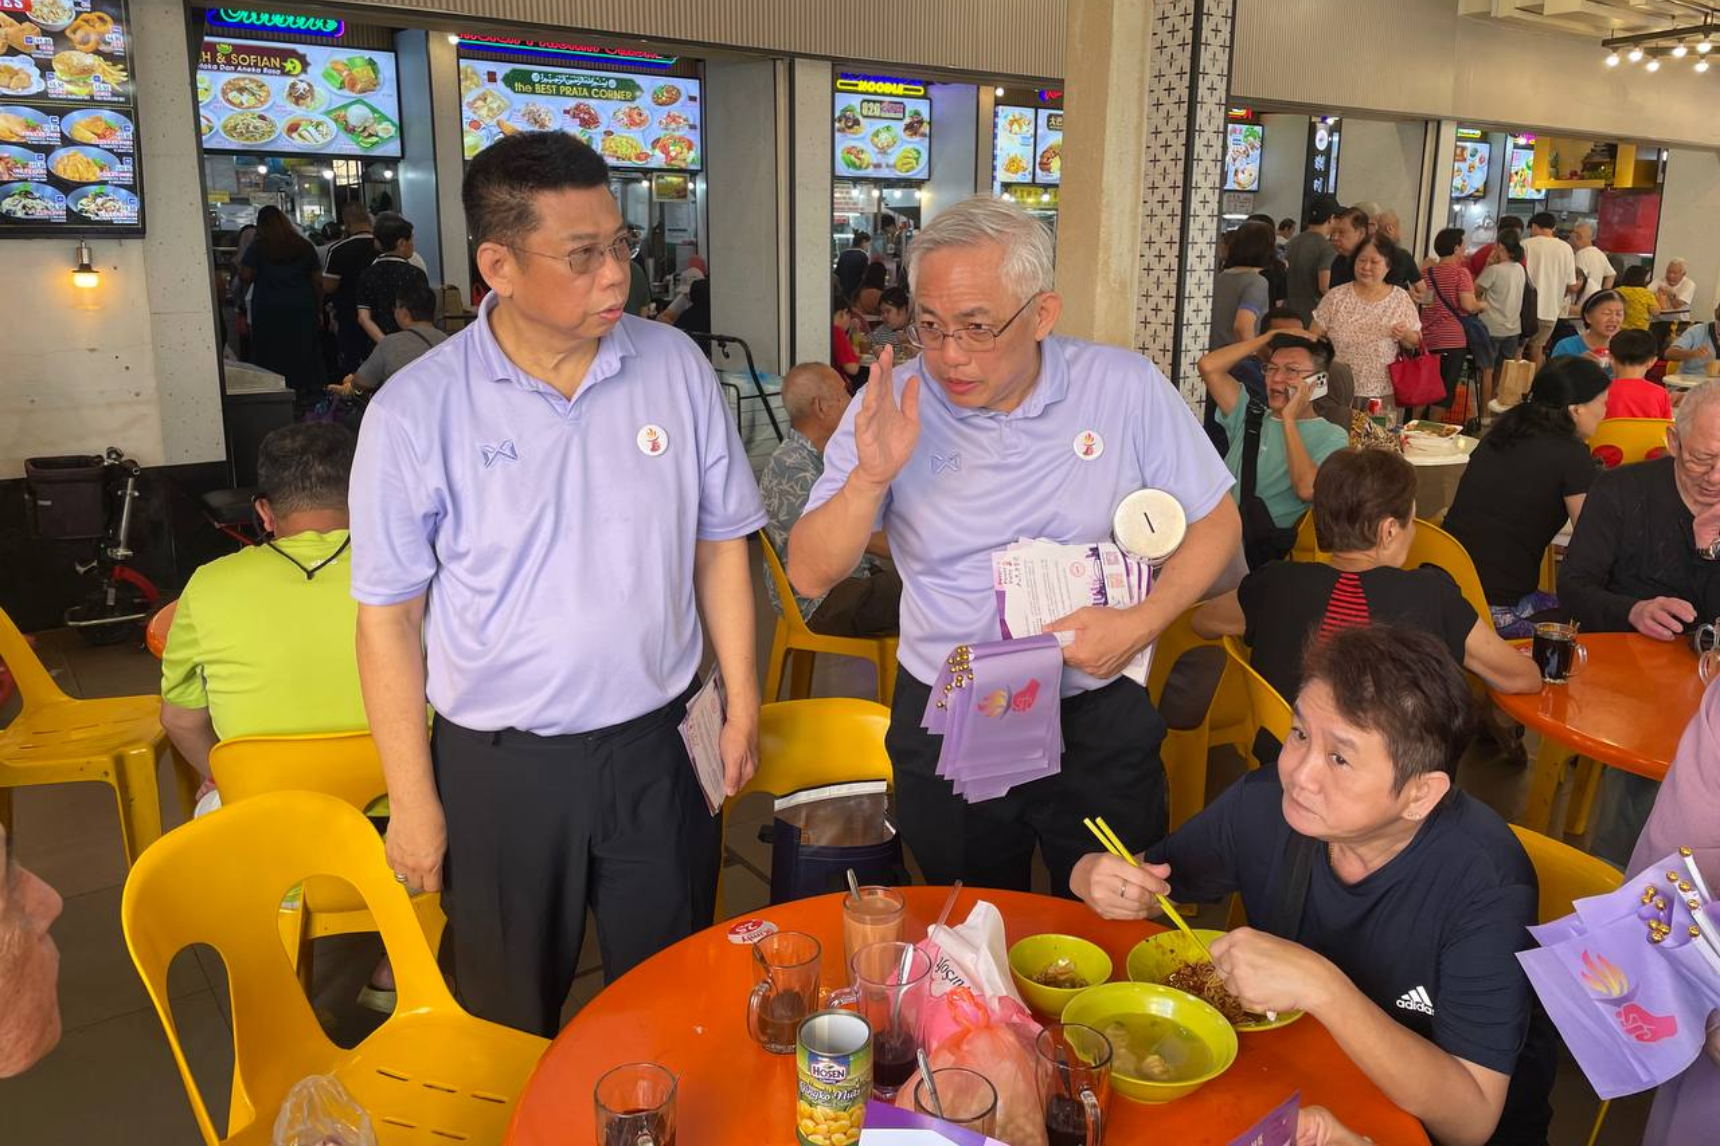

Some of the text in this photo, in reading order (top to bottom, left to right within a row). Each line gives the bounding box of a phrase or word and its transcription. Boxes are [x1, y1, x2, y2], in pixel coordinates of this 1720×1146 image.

[201, 51, 280, 68] H & SOFIAN
[515, 82, 633, 100] the BEST PRATA CORNER
[735, 921, 758, 933] 25
[812, 1065, 845, 1078] HOSEN
